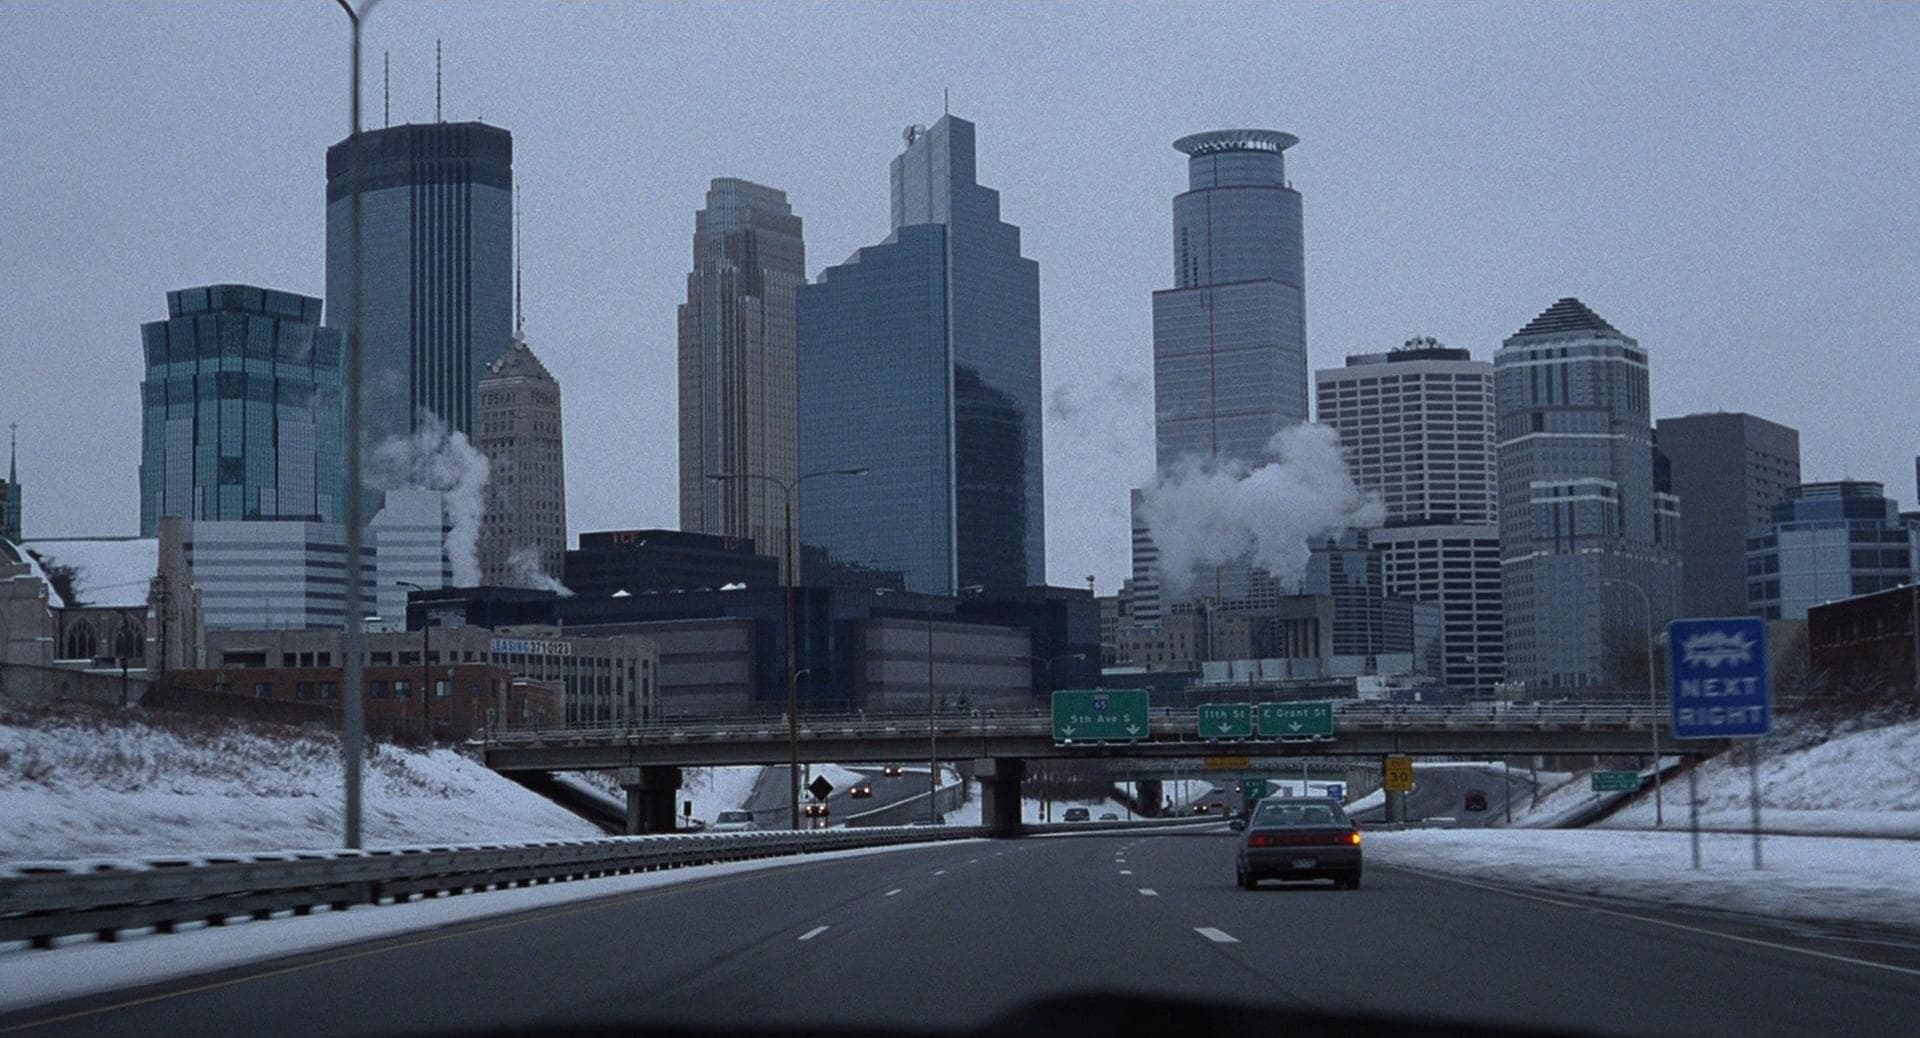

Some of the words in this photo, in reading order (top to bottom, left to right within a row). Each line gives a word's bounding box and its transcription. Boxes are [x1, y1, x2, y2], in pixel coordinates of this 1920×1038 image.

[1681, 677, 1759, 697] NEXT
[1096, 714, 1118, 723] Ave
[1123, 713, 1131, 723] S
[1204, 710, 1228, 719] 11th
[1233, 710, 1245, 718] St
[1263, 709, 1271, 718] E
[1276, 709, 1308, 718] Grant
[1314, 708, 1326, 717] St
[1678, 706, 1763, 725] RIGHT
[1391, 771, 1409, 782] 30
